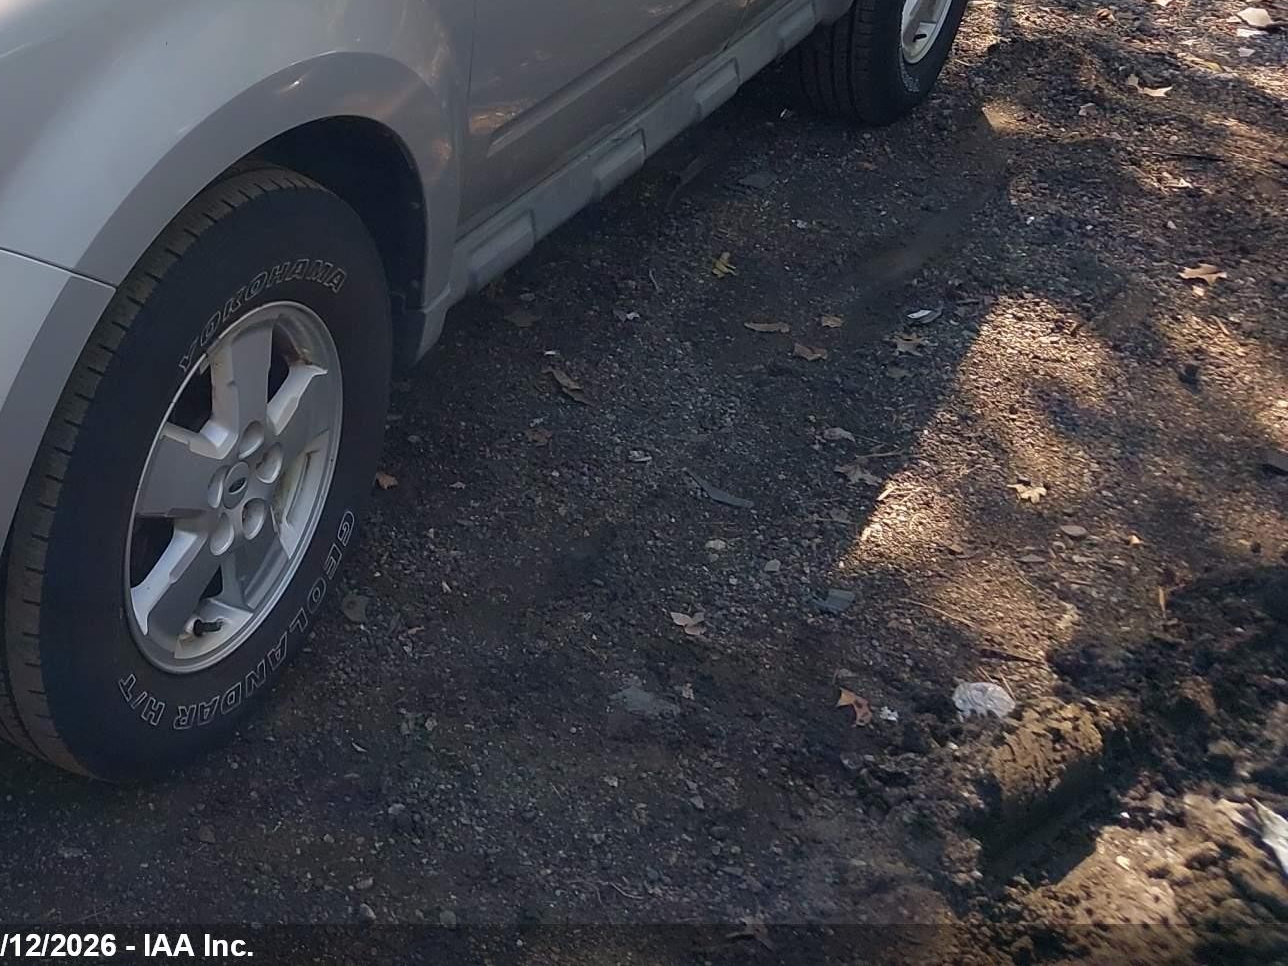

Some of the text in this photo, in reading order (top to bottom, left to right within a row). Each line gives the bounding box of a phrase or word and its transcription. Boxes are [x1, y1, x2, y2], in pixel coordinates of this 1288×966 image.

[178, 258, 347, 372] YOKOHAMA
[118, 510, 355, 730] GEOLANDAR H/T
